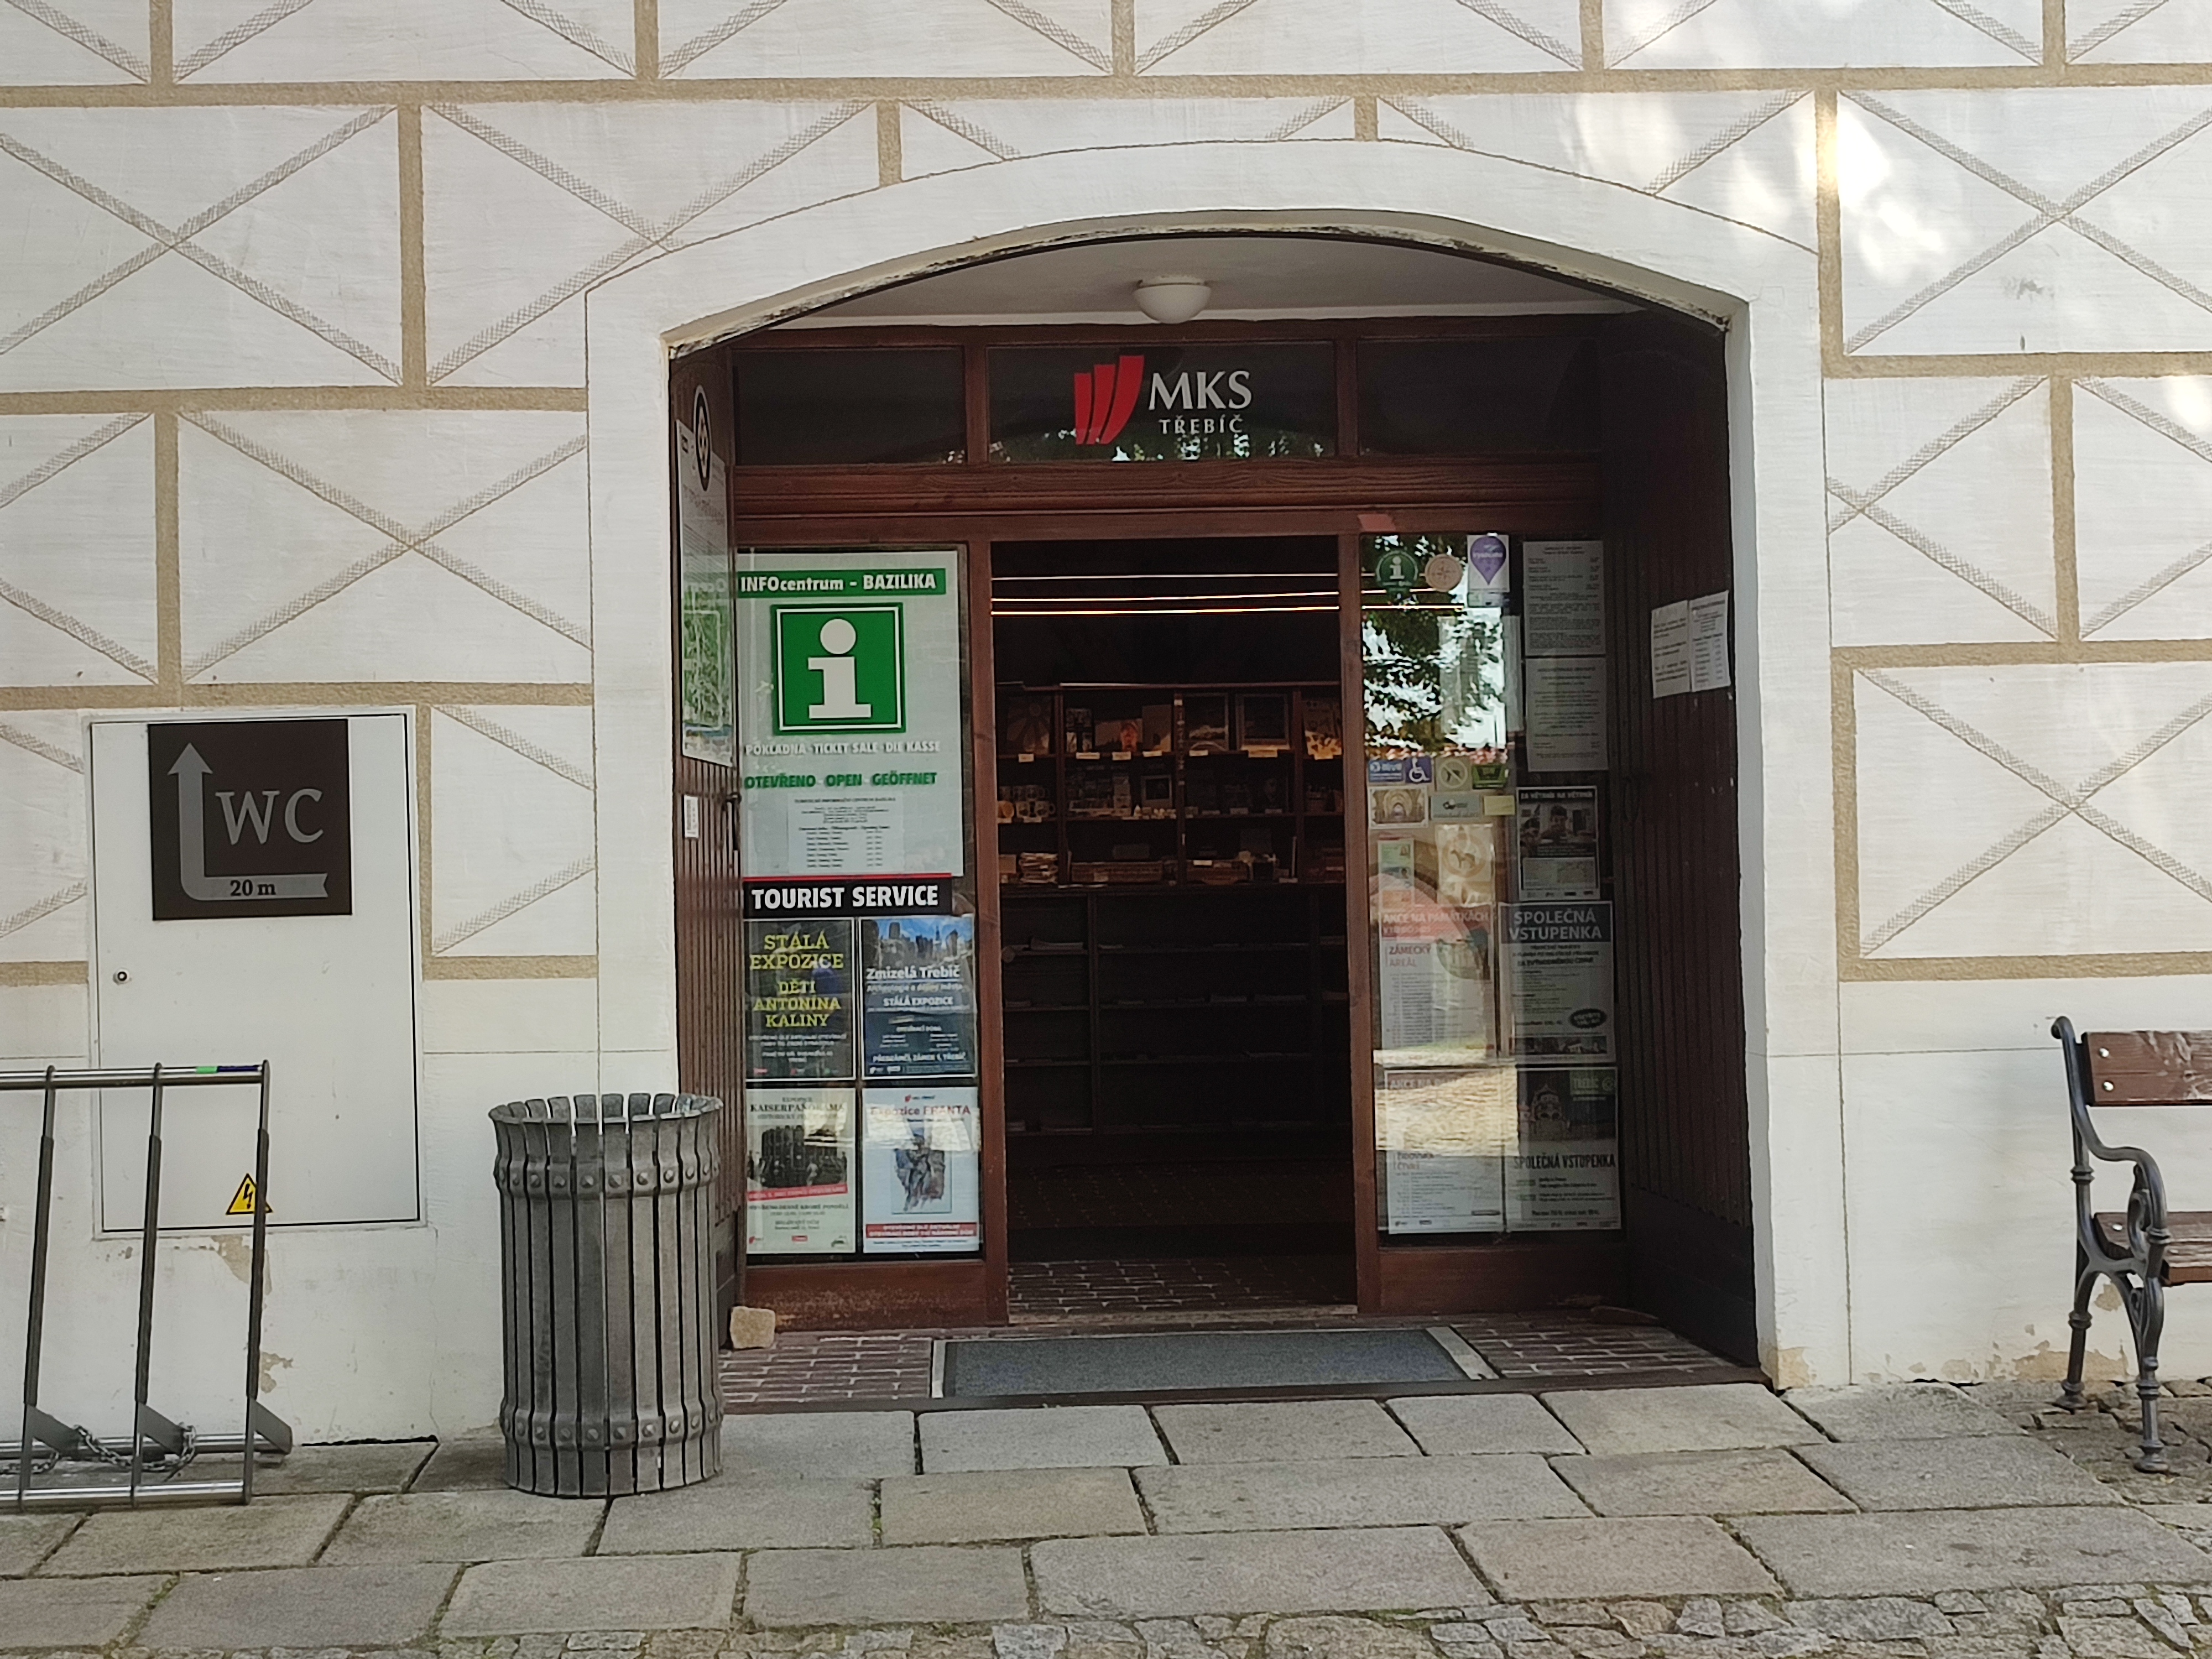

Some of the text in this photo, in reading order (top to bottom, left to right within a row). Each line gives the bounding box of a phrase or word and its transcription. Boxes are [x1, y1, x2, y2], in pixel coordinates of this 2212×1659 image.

[1149, 371, 1252, 410] MKS
[1159, 414, 1243, 434] TŘEBÍČ
[741, 576, 844, 592] INFOcentrum
[863, 573, 936, 590] BAZILIKA
[746, 740, 940, 756] POKLADNA TICKET SALE DIE KASSE
[744, 770, 938, 789] OTEVŘENO OPEN GEÖFFNET
[215, 788, 324, 846] WC
[230, 879, 276, 896] 20 m
[752, 885, 938, 909] TOURIST SERVICE
[1514, 907, 1597, 925] SPOLEČNÁ
[764, 930, 830, 950] STÁLÁ
[1509, 926, 1602, 940] VSTUPENKA
[749, 953, 844, 969] EXPOZICE
[866, 964, 961, 979] Zmizelá Třebíč
[778, 978, 816, 994] DĚTI
[765, 1014, 830, 1027] KALINY
[1513, 1152, 1616, 1169] SPOLEČNÁ VSTUPENKA
